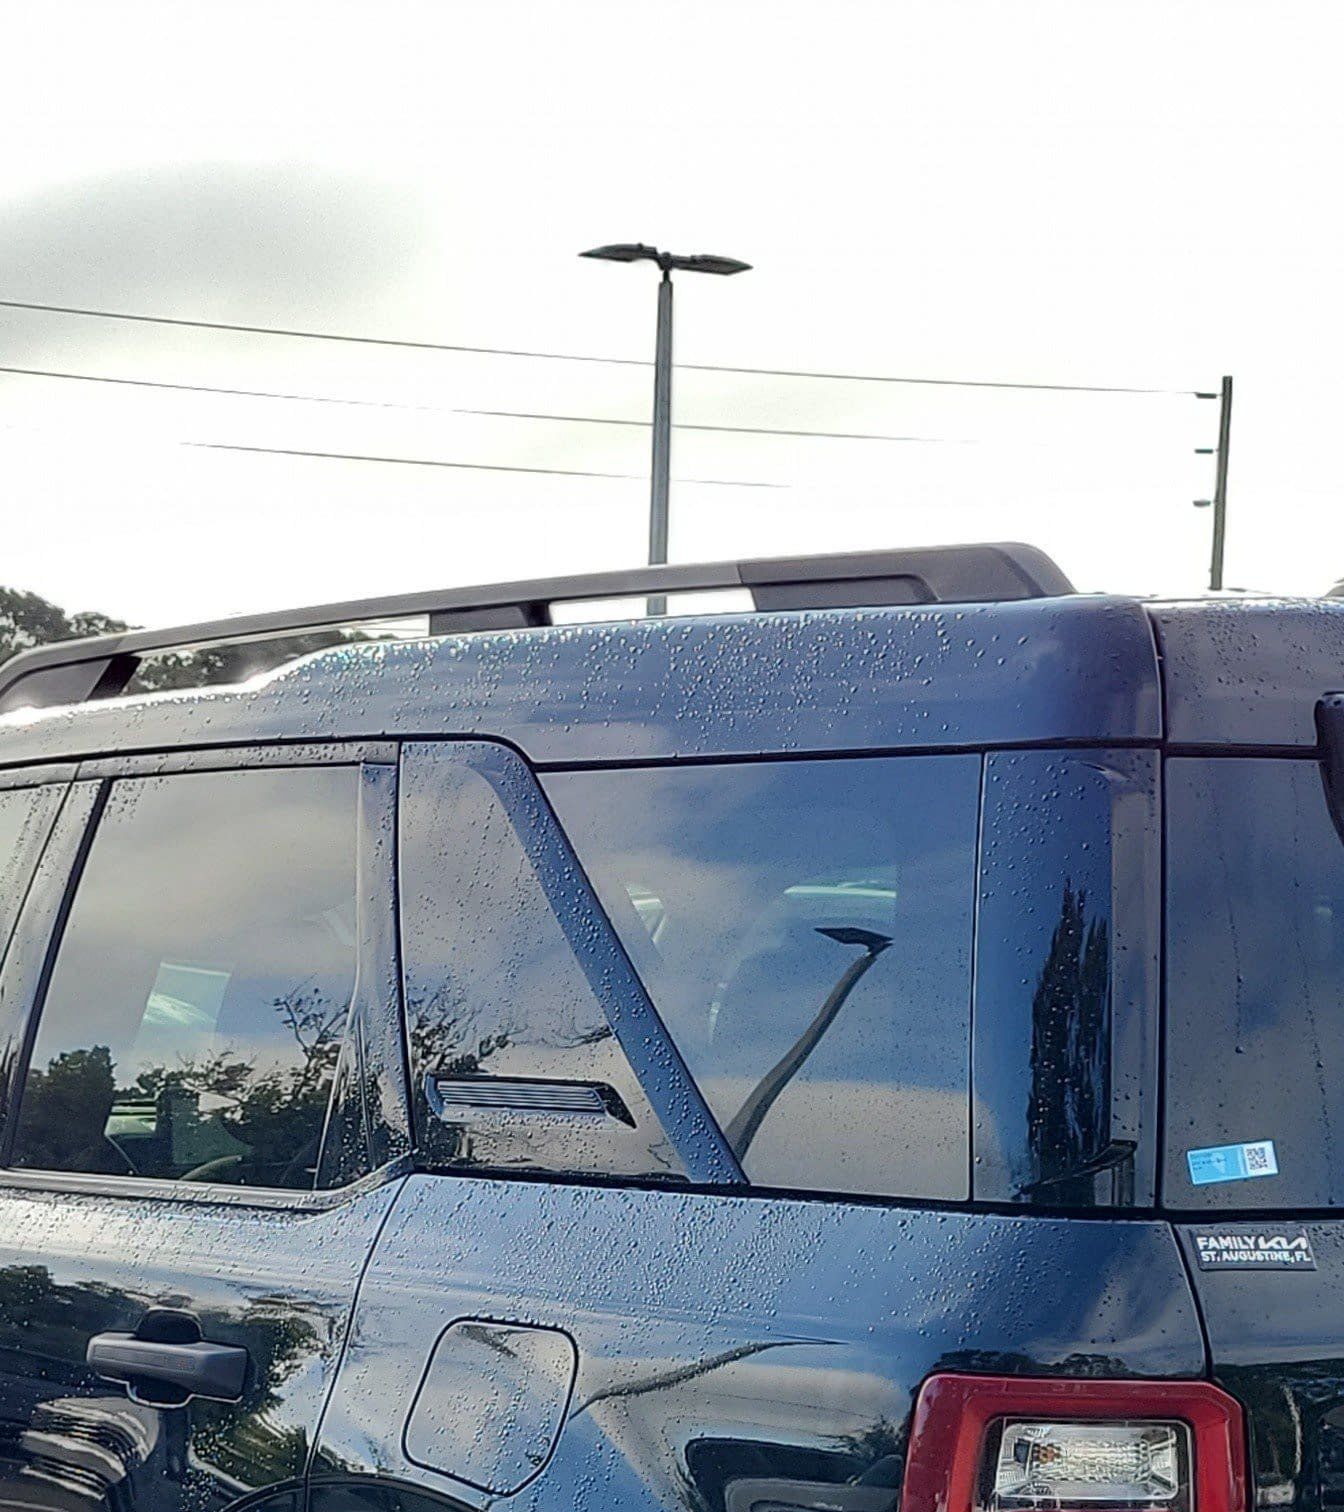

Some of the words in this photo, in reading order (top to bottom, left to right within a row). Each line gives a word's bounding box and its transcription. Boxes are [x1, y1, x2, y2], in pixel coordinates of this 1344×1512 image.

[1197, 1235, 1256, 1250] FAMILY
[1258, 1235, 1308, 1250] KIA
[1295, 1251, 1311, 1261] FL
